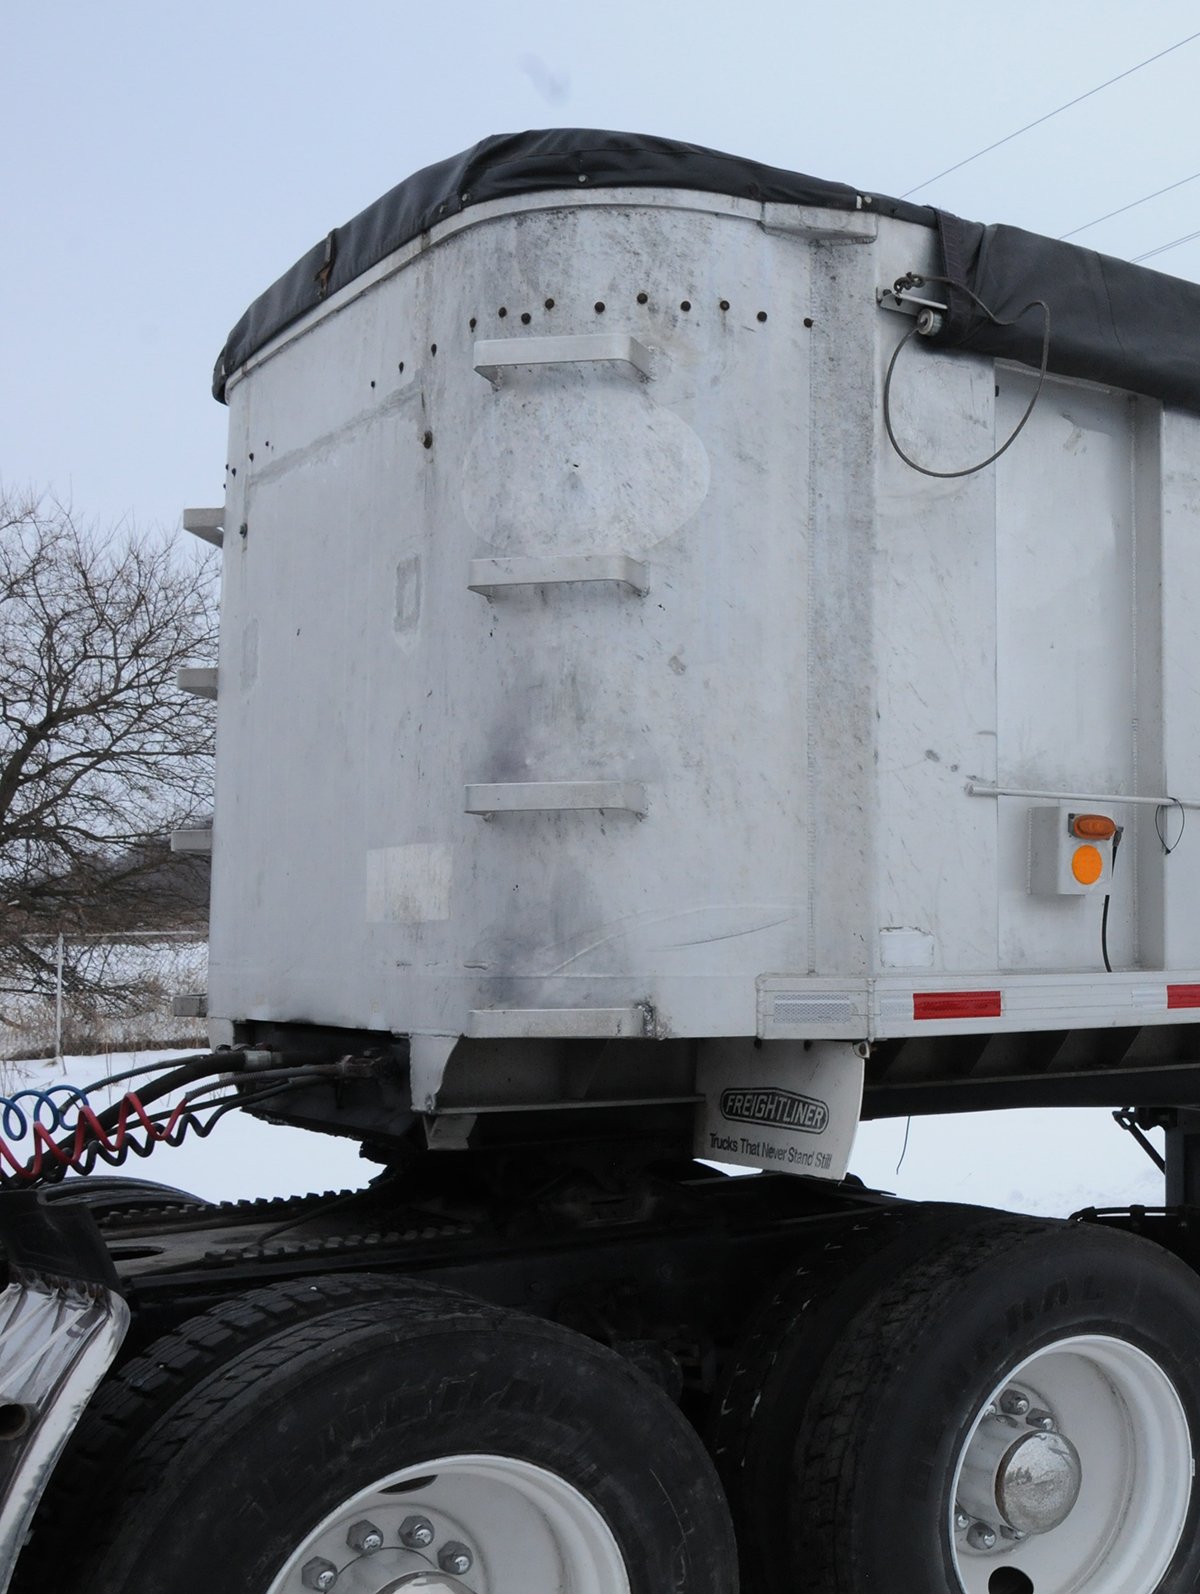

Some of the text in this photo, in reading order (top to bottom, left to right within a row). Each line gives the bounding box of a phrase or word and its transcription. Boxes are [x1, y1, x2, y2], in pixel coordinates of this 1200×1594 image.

[725, 1094, 825, 1128] FREIGHTLINER
[709, 1132, 833, 1170] Trucks That Never Stand Still
